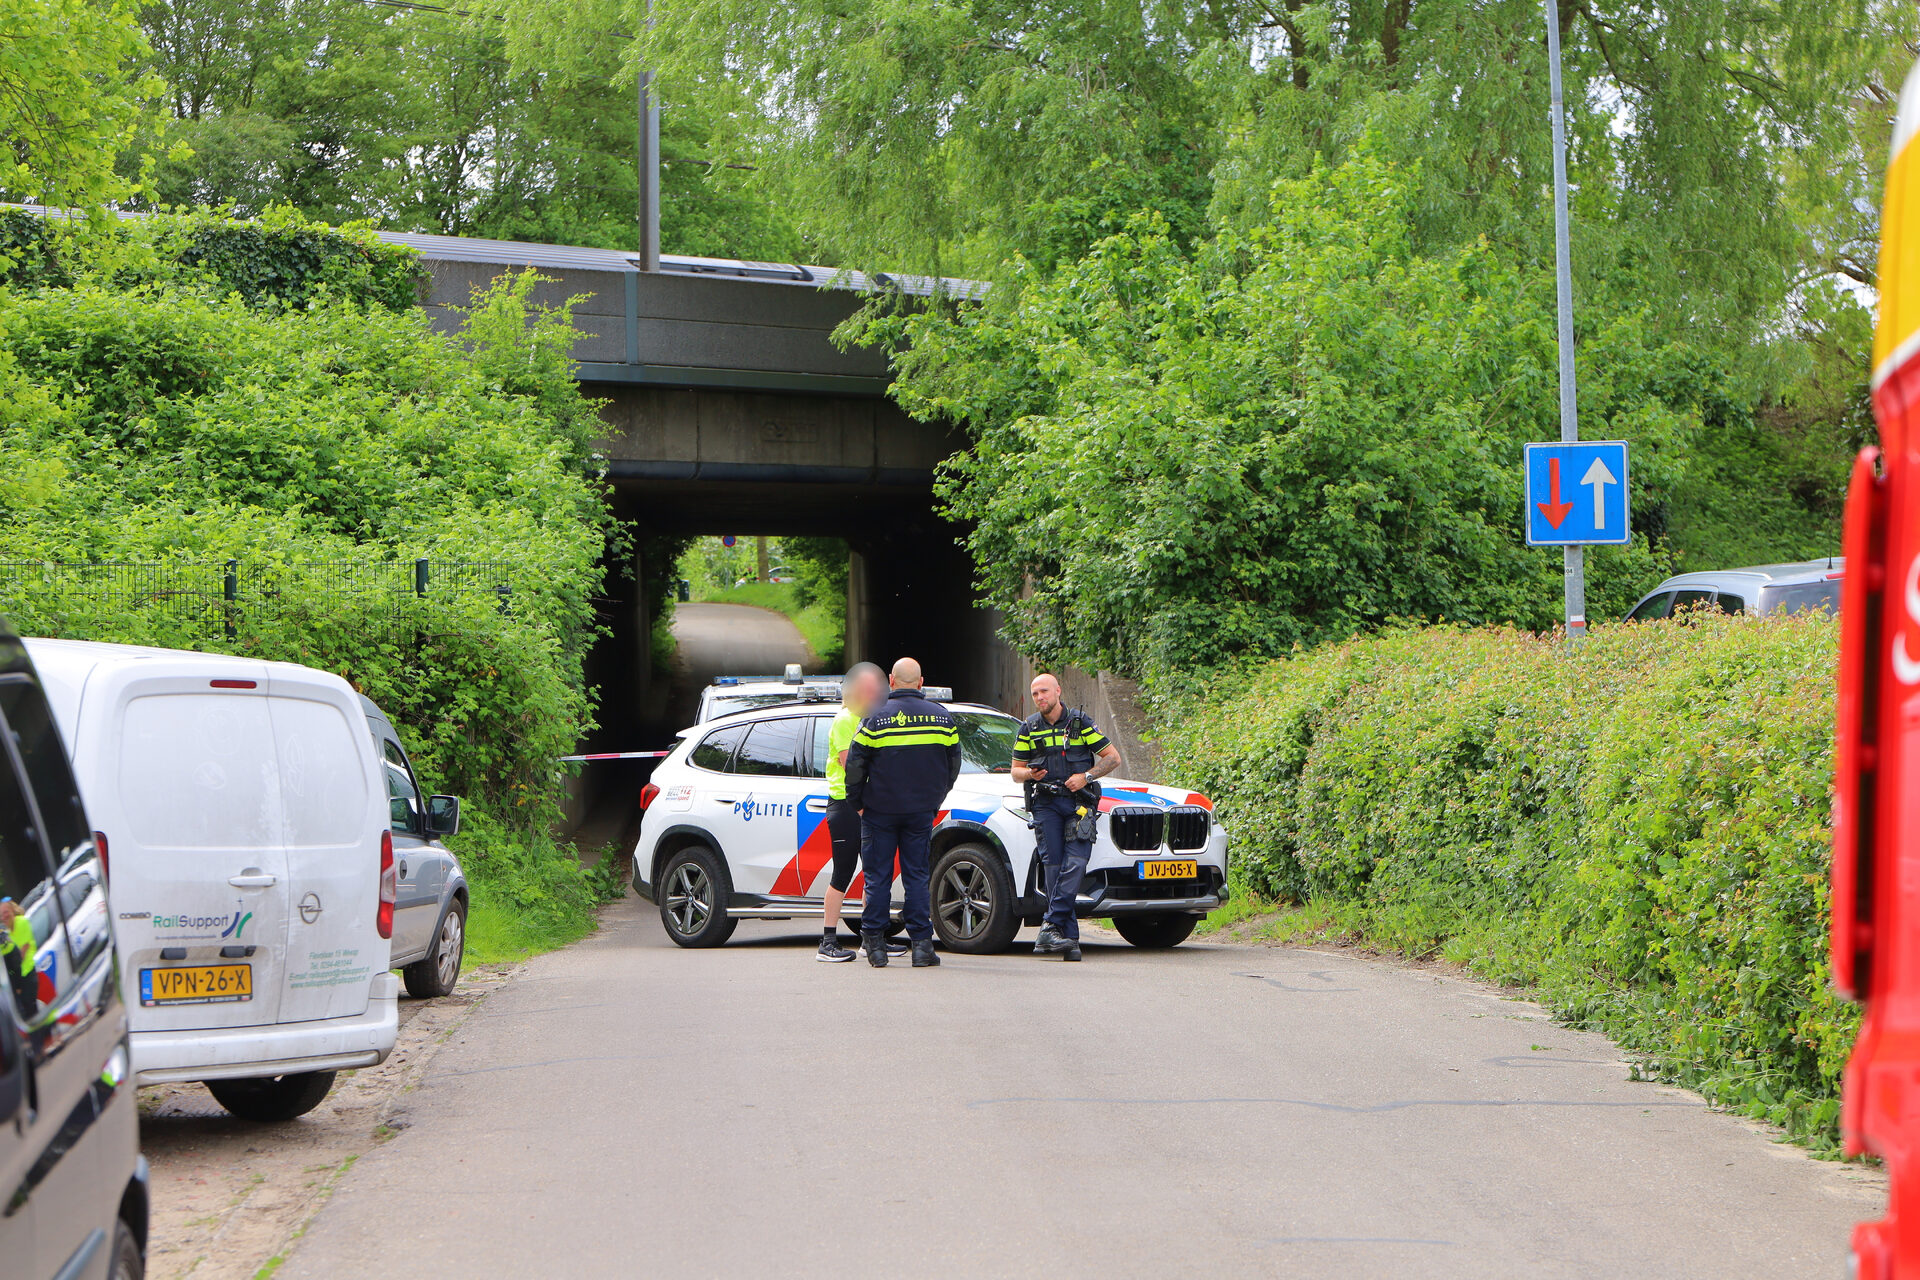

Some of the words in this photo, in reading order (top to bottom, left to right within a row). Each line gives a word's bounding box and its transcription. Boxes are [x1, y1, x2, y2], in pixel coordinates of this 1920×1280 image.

[1149, 864, 1193, 876] JVJ-05-X
[153, 915, 229, 930] RailSupport
[158, 969, 246, 994] VPN-26-X
